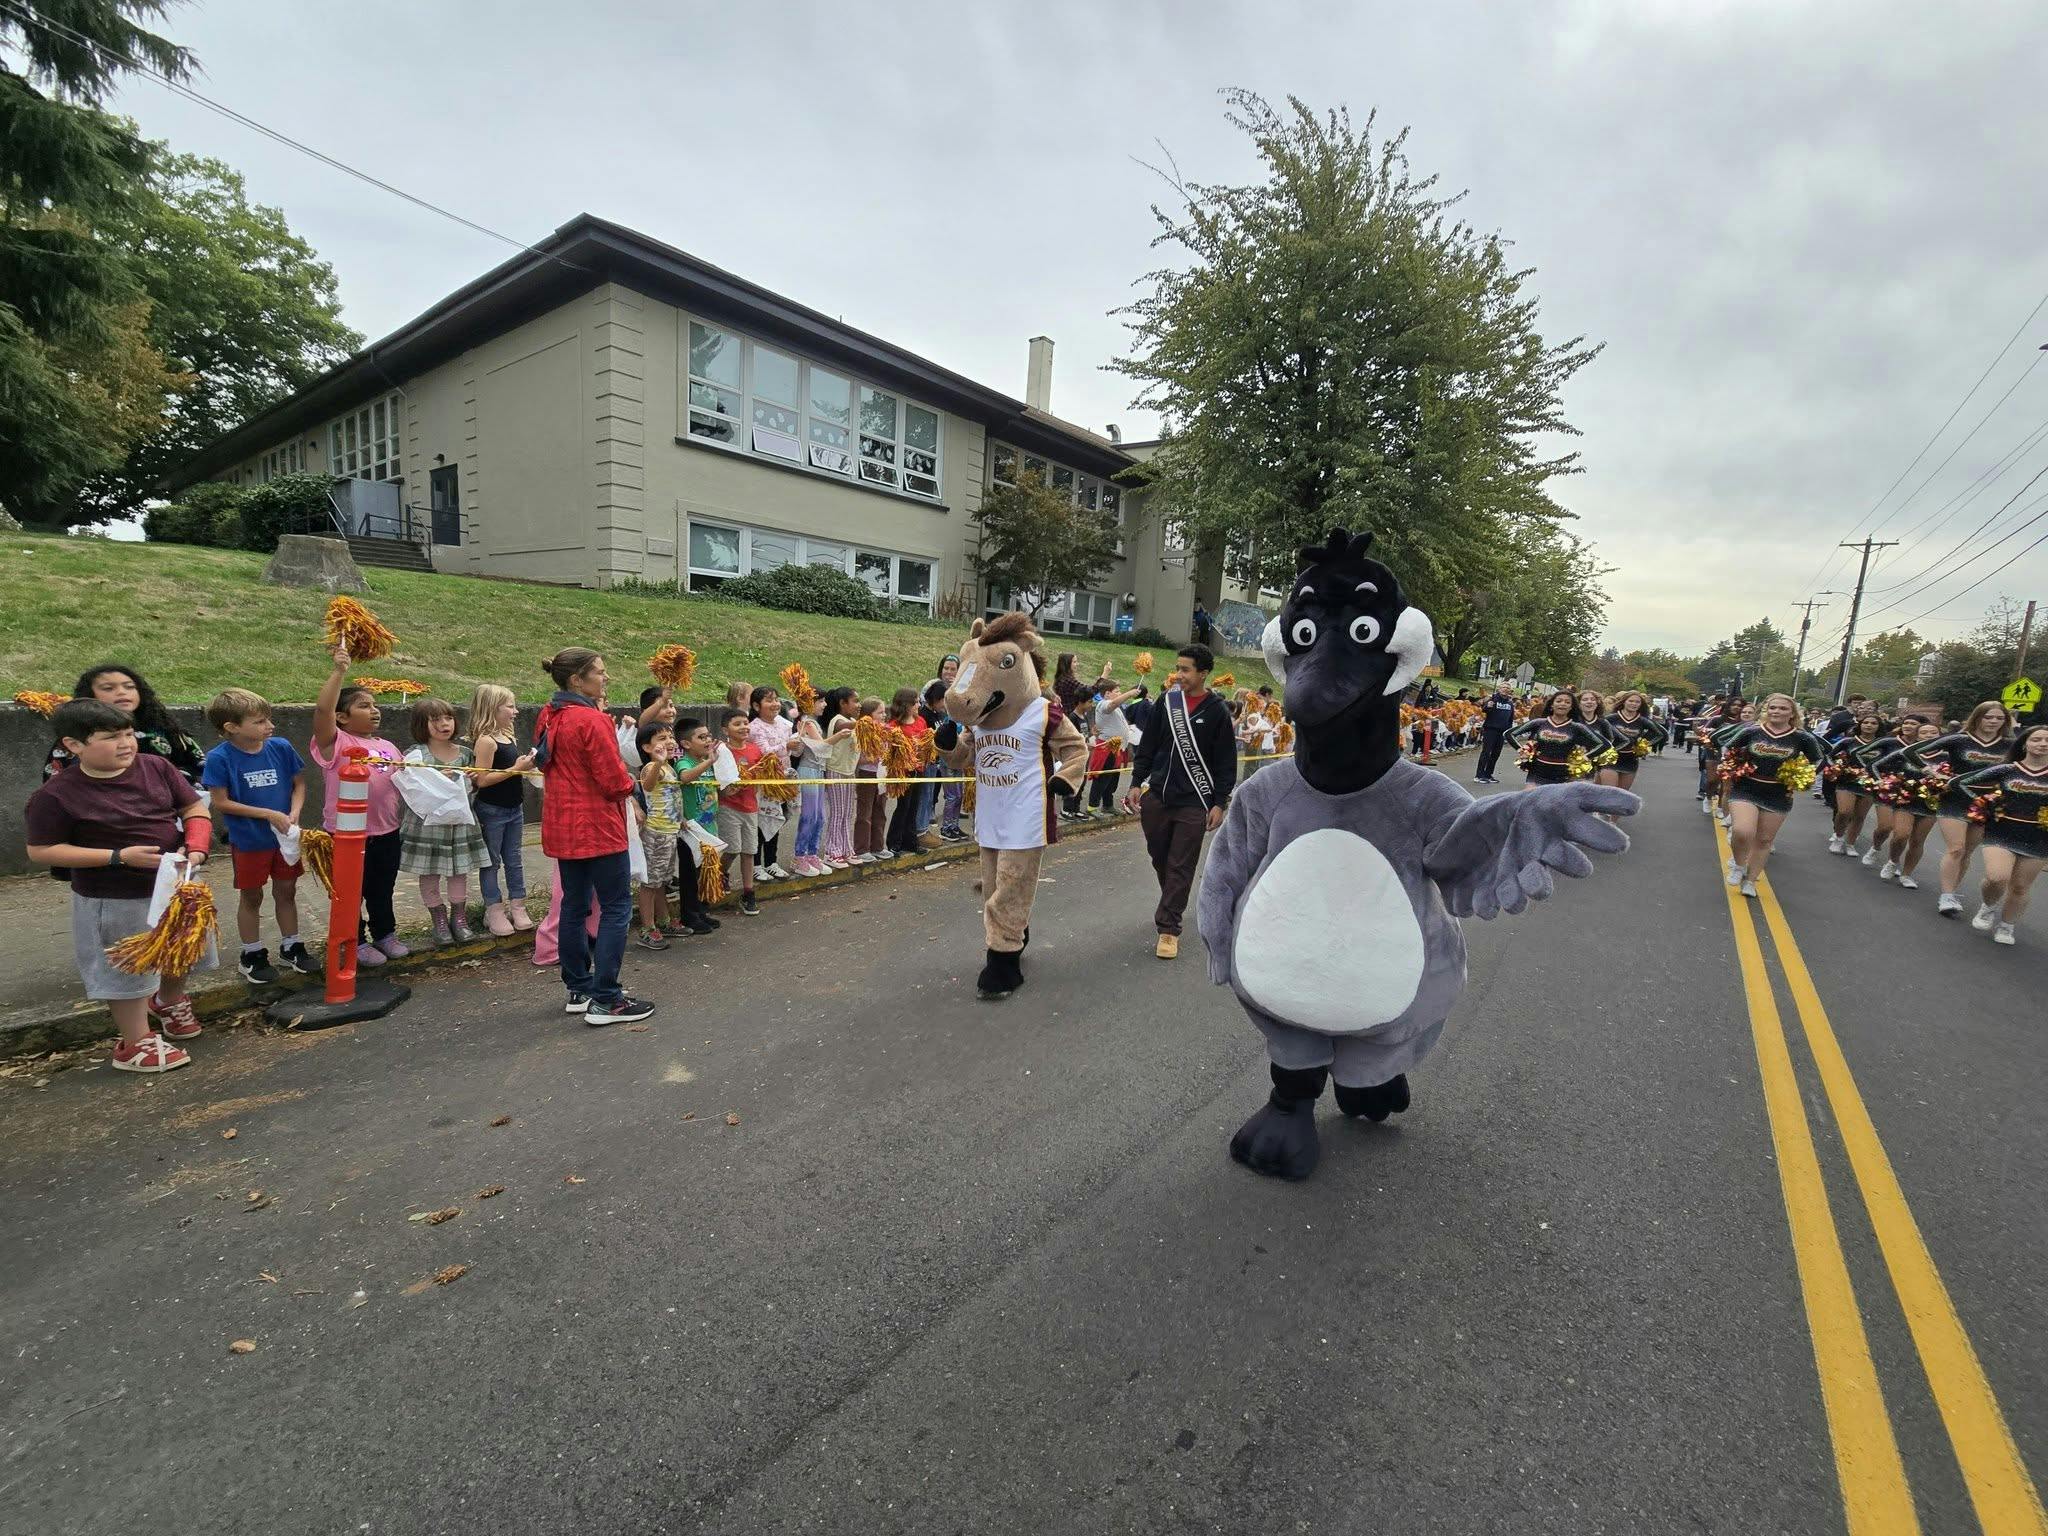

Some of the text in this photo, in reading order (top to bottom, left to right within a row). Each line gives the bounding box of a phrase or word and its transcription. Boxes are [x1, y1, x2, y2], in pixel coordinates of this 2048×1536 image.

[1172, 708, 1212, 795] MILWAUKIEST MASCOT
[243, 772, 278, 782] TRACK
[248, 779, 278, 788] FIELD
